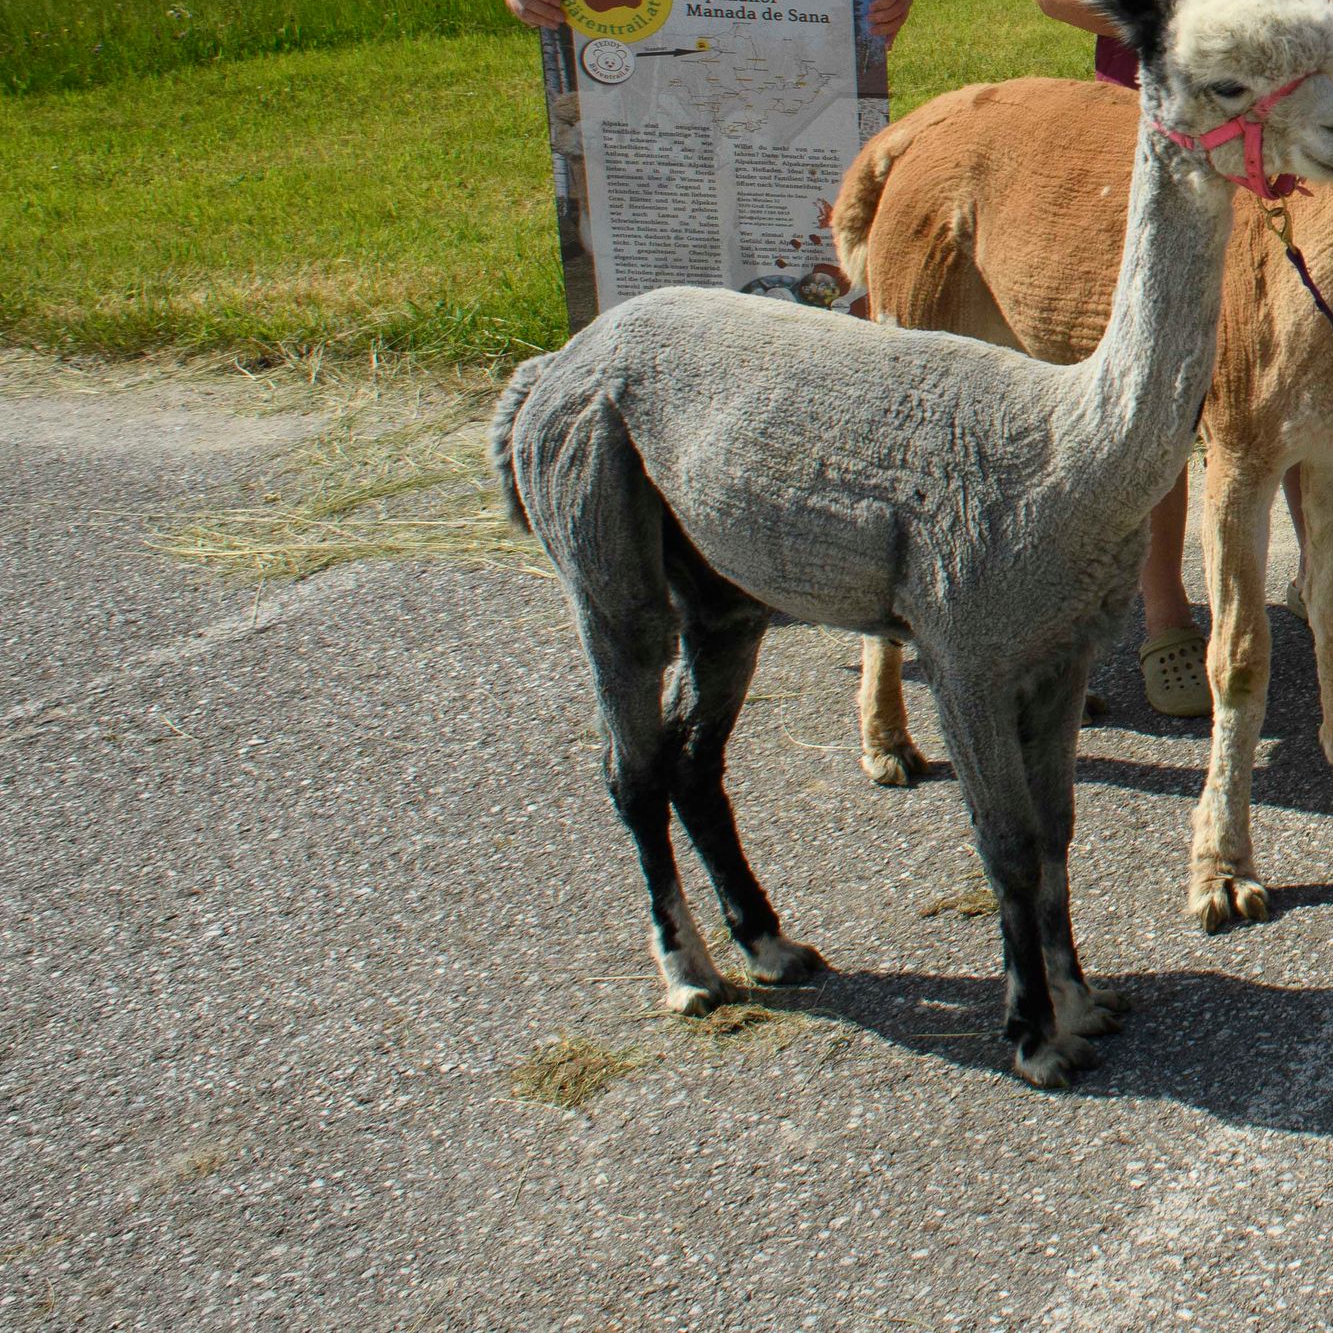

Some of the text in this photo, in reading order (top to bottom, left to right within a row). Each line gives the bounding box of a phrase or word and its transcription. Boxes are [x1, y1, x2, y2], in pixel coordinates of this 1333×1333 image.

[686, 3, 830, 24] Manada de Sana
[594, 40, 622, 49] TEDDY
